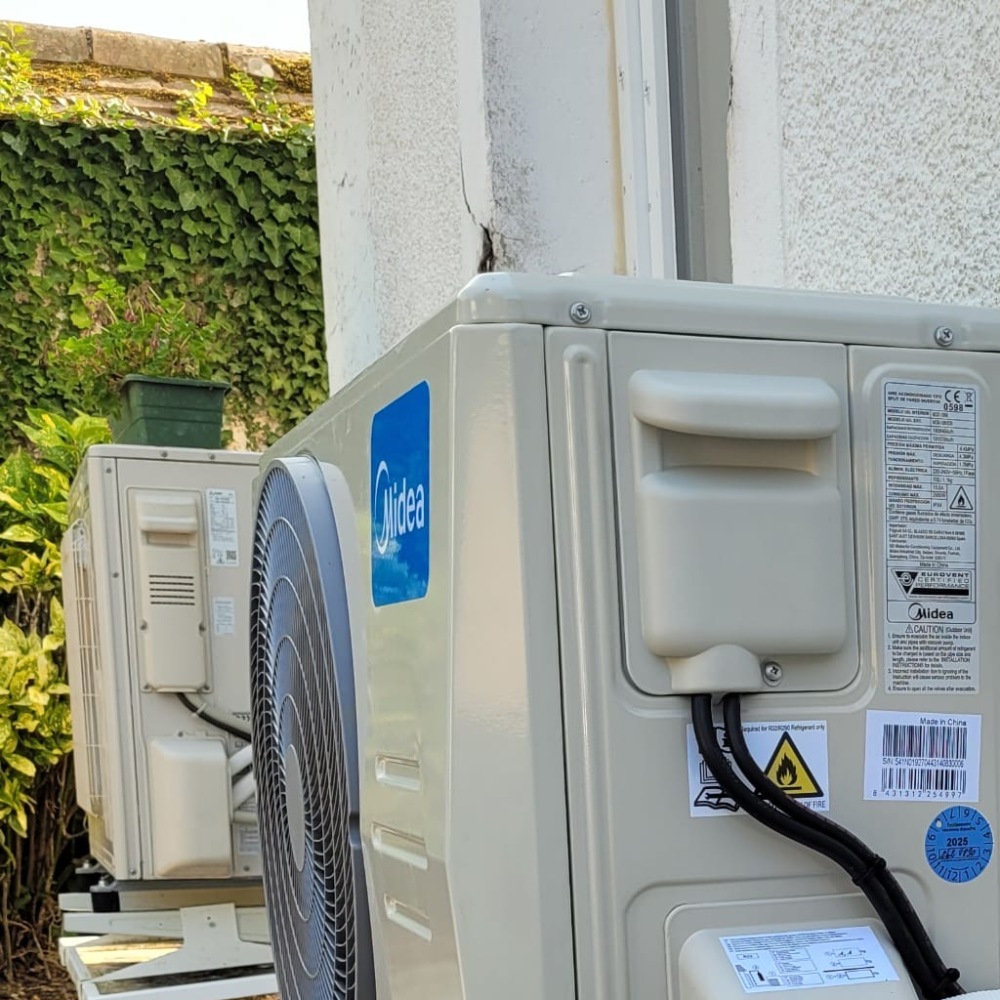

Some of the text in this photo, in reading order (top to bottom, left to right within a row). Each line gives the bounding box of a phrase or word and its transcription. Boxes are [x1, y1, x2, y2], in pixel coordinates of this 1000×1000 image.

[943, 403, 964, 411] 0598
[375, 461, 424, 554] Midea
[908, 602, 953, 620] Midea
[914, 625, 944, 633] CAUTION
[812, 800, 826, 808] FIRE
[946, 837, 968, 847] 2025
